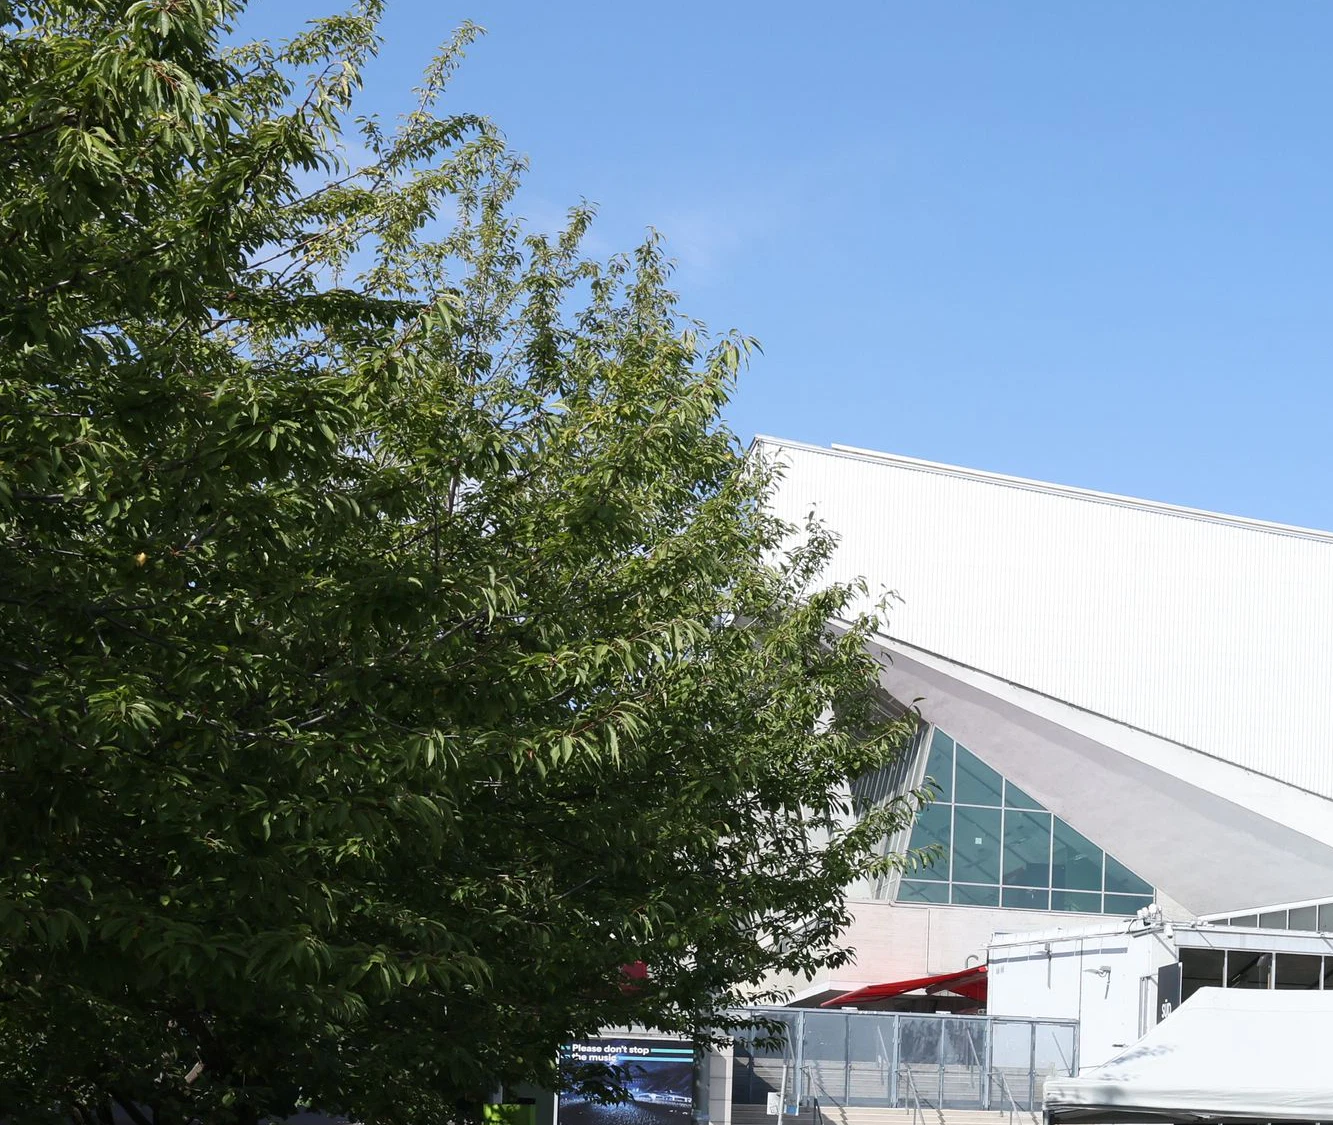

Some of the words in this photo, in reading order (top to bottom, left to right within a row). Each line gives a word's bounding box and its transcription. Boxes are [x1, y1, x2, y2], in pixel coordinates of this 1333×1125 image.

[572, 1044, 602, 1053] Please
[604, 1045, 628, 1054] don't
[630, 1046, 650, 1056] stop
[572, 1053, 586, 1061] the
[589, 1053, 617, 1062] music
